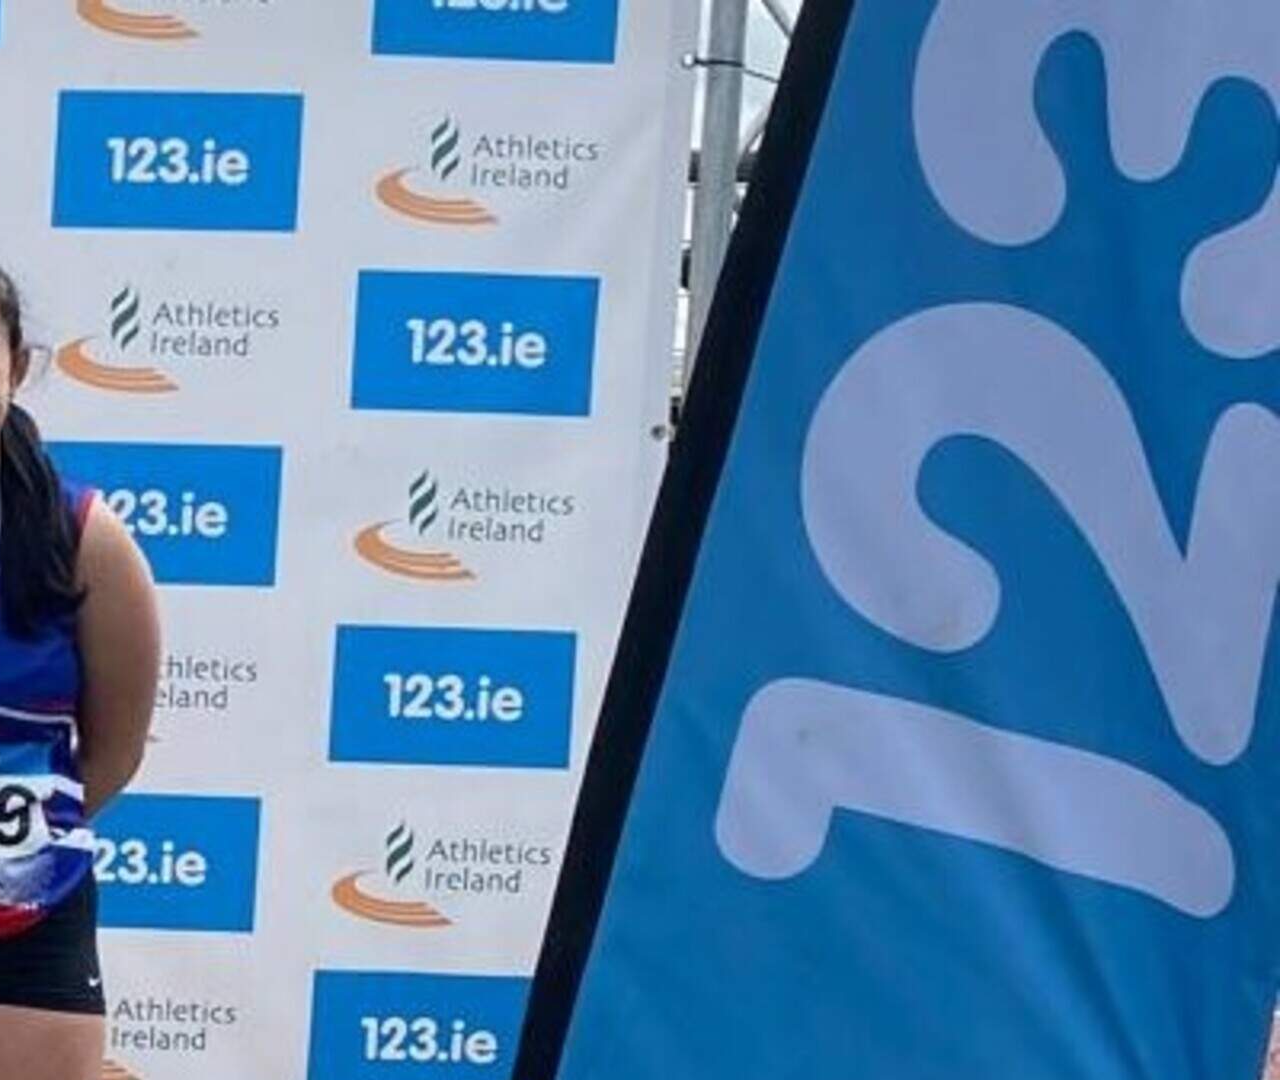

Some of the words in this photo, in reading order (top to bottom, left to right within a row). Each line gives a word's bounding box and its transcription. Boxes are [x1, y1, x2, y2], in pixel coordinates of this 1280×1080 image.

[473, 135, 598, 160] Athletics
[107, 138, 249, 185] 123.ie
[471, 163, 568, 190] Ireland
[153, 301, 279, 327] Athletics
[151, 330, 249, 356] Ireland
[407, 319, 547, 368] 123.ie
[449, 488, 574, 516] Athletics
[448, 517, 544, 543] Ireland
[384, 674, 523, 722] 123.ie
[93, 838, 206, 884] 23.ie
[425, 838, 551, 865] Athletics
[424, 867, 522, 893] Ireland
[113, 997, 236, 1024] Athletics
[111, 1026, 207, 1051] Ireland
[361, 1017, 498, 1064] 123.ie
